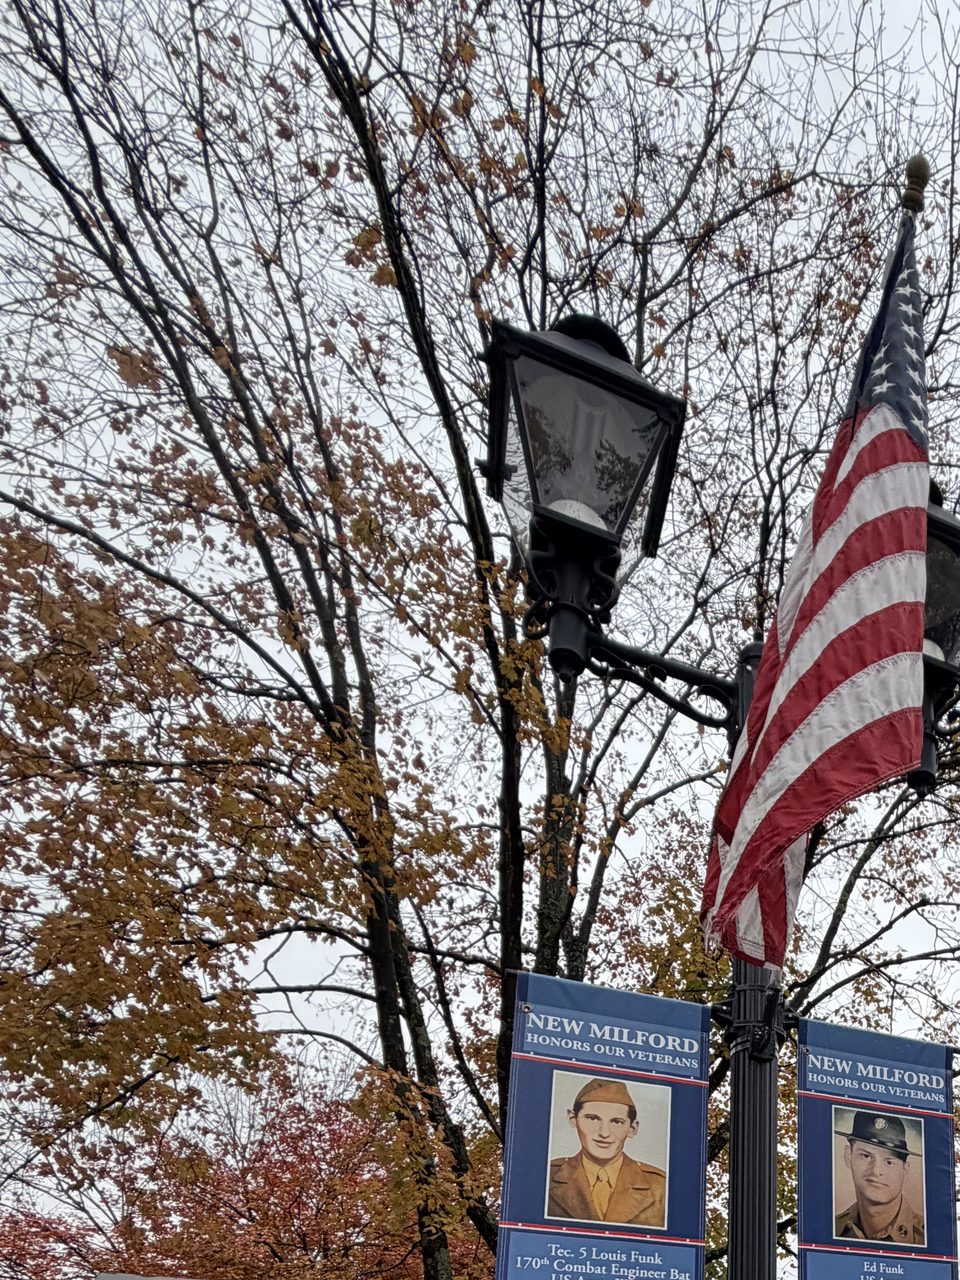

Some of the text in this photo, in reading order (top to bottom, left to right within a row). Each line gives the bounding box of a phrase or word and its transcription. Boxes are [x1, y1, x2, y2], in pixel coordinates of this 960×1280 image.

[527, 1013, 699, 1053] NEW MILFORD
[526, 1033, 698, 1069] HONORS OUR VETERANS
[808, 1054, 944, 1089] NEW MILFORD
[808, 1072, 945, 1103] HONORS OUR VETERANS
[515, 1256, 690, 1280] 170th Combat Engineer Bat
[547, 1244, 663, 1265] Tec. 5 Louis Funk
[863, 1261, 904, 1275] Ed Funk
